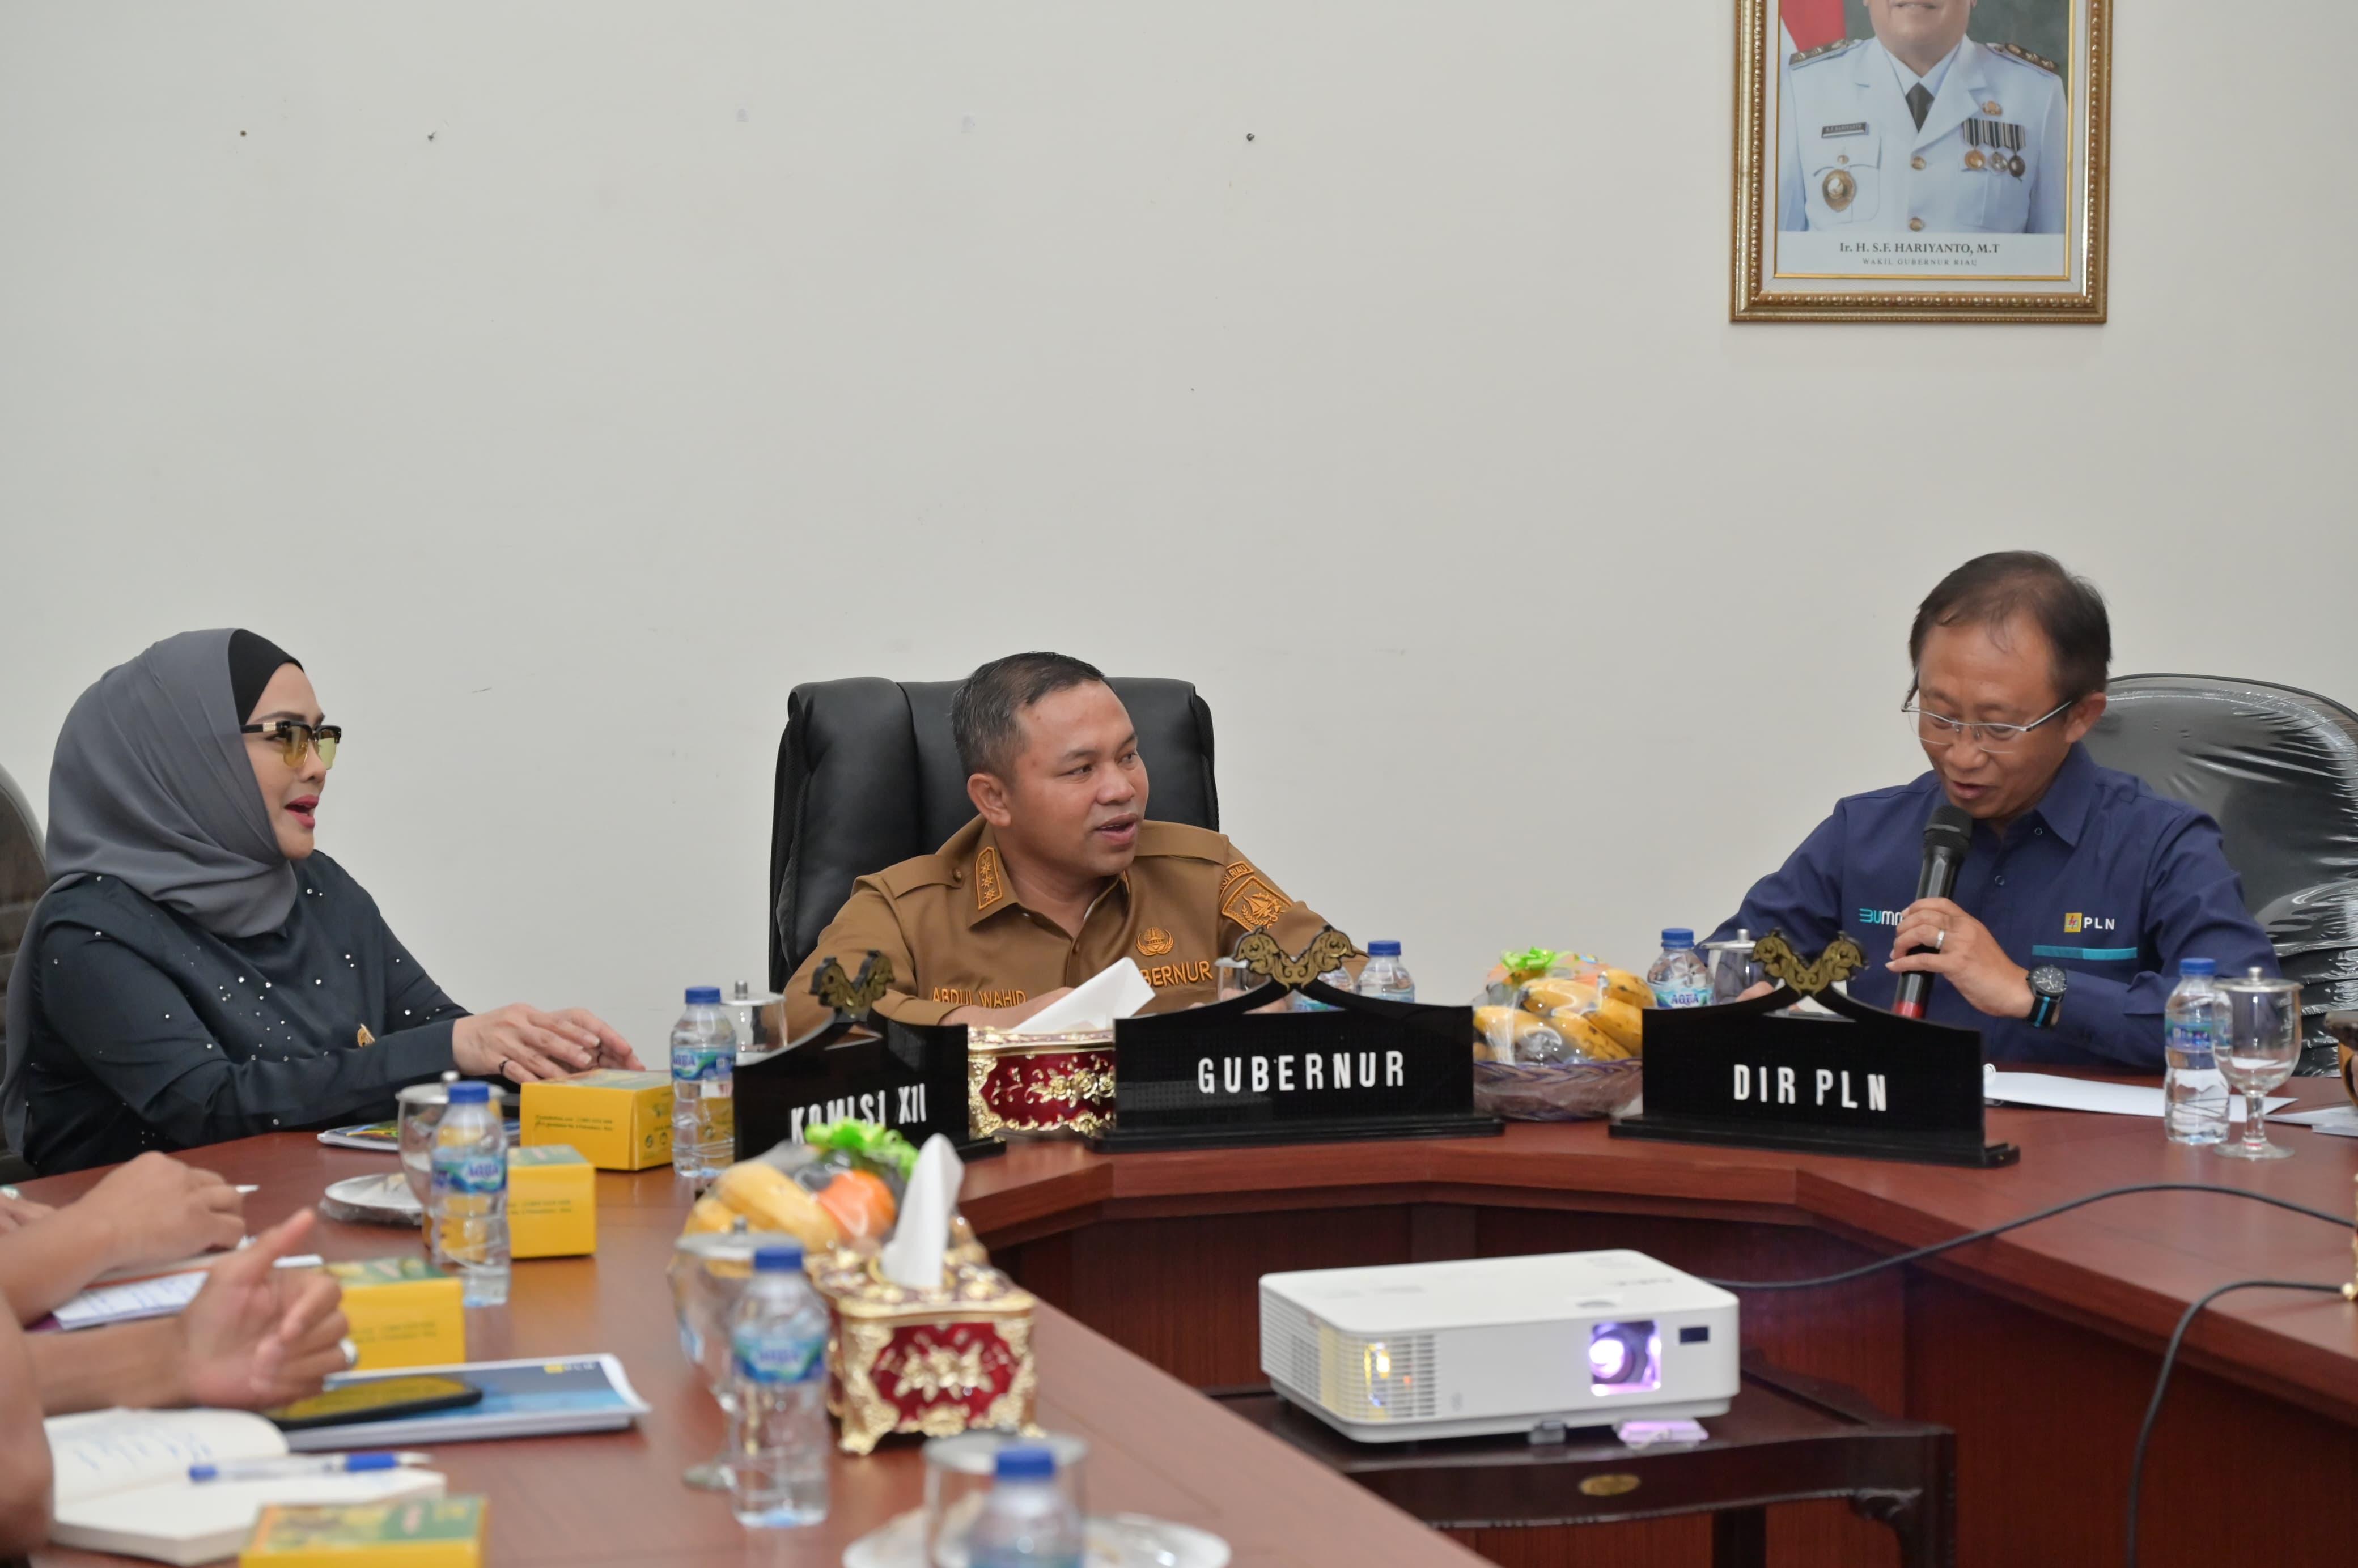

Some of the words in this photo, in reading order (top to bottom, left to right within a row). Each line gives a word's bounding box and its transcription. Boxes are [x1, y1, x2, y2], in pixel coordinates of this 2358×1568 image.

[1840, 243, 1852, 252] Ir.
[1856, 243, 1869, 253] H.
[1872, 243, 1891, 253] S.F.
[1895, 243, 1973, 255] HARIYANTO,
[1977, 244, 2000, 253] M.T
[1228, 865, 1247, 877] RIAU
[2084, 917, 2115, 930] PLN
[1140, 961, 1214, 987] BERNUR
[979, 988, 1027, 1008] WAHID
[1198, 1050, 1403, 1094] GUBERNUR
[1733, 1064, 1796, 1104] DIR
[1816, 1069, 1887, 1112] PLN
[898, 1083, 927, 1124] XII
